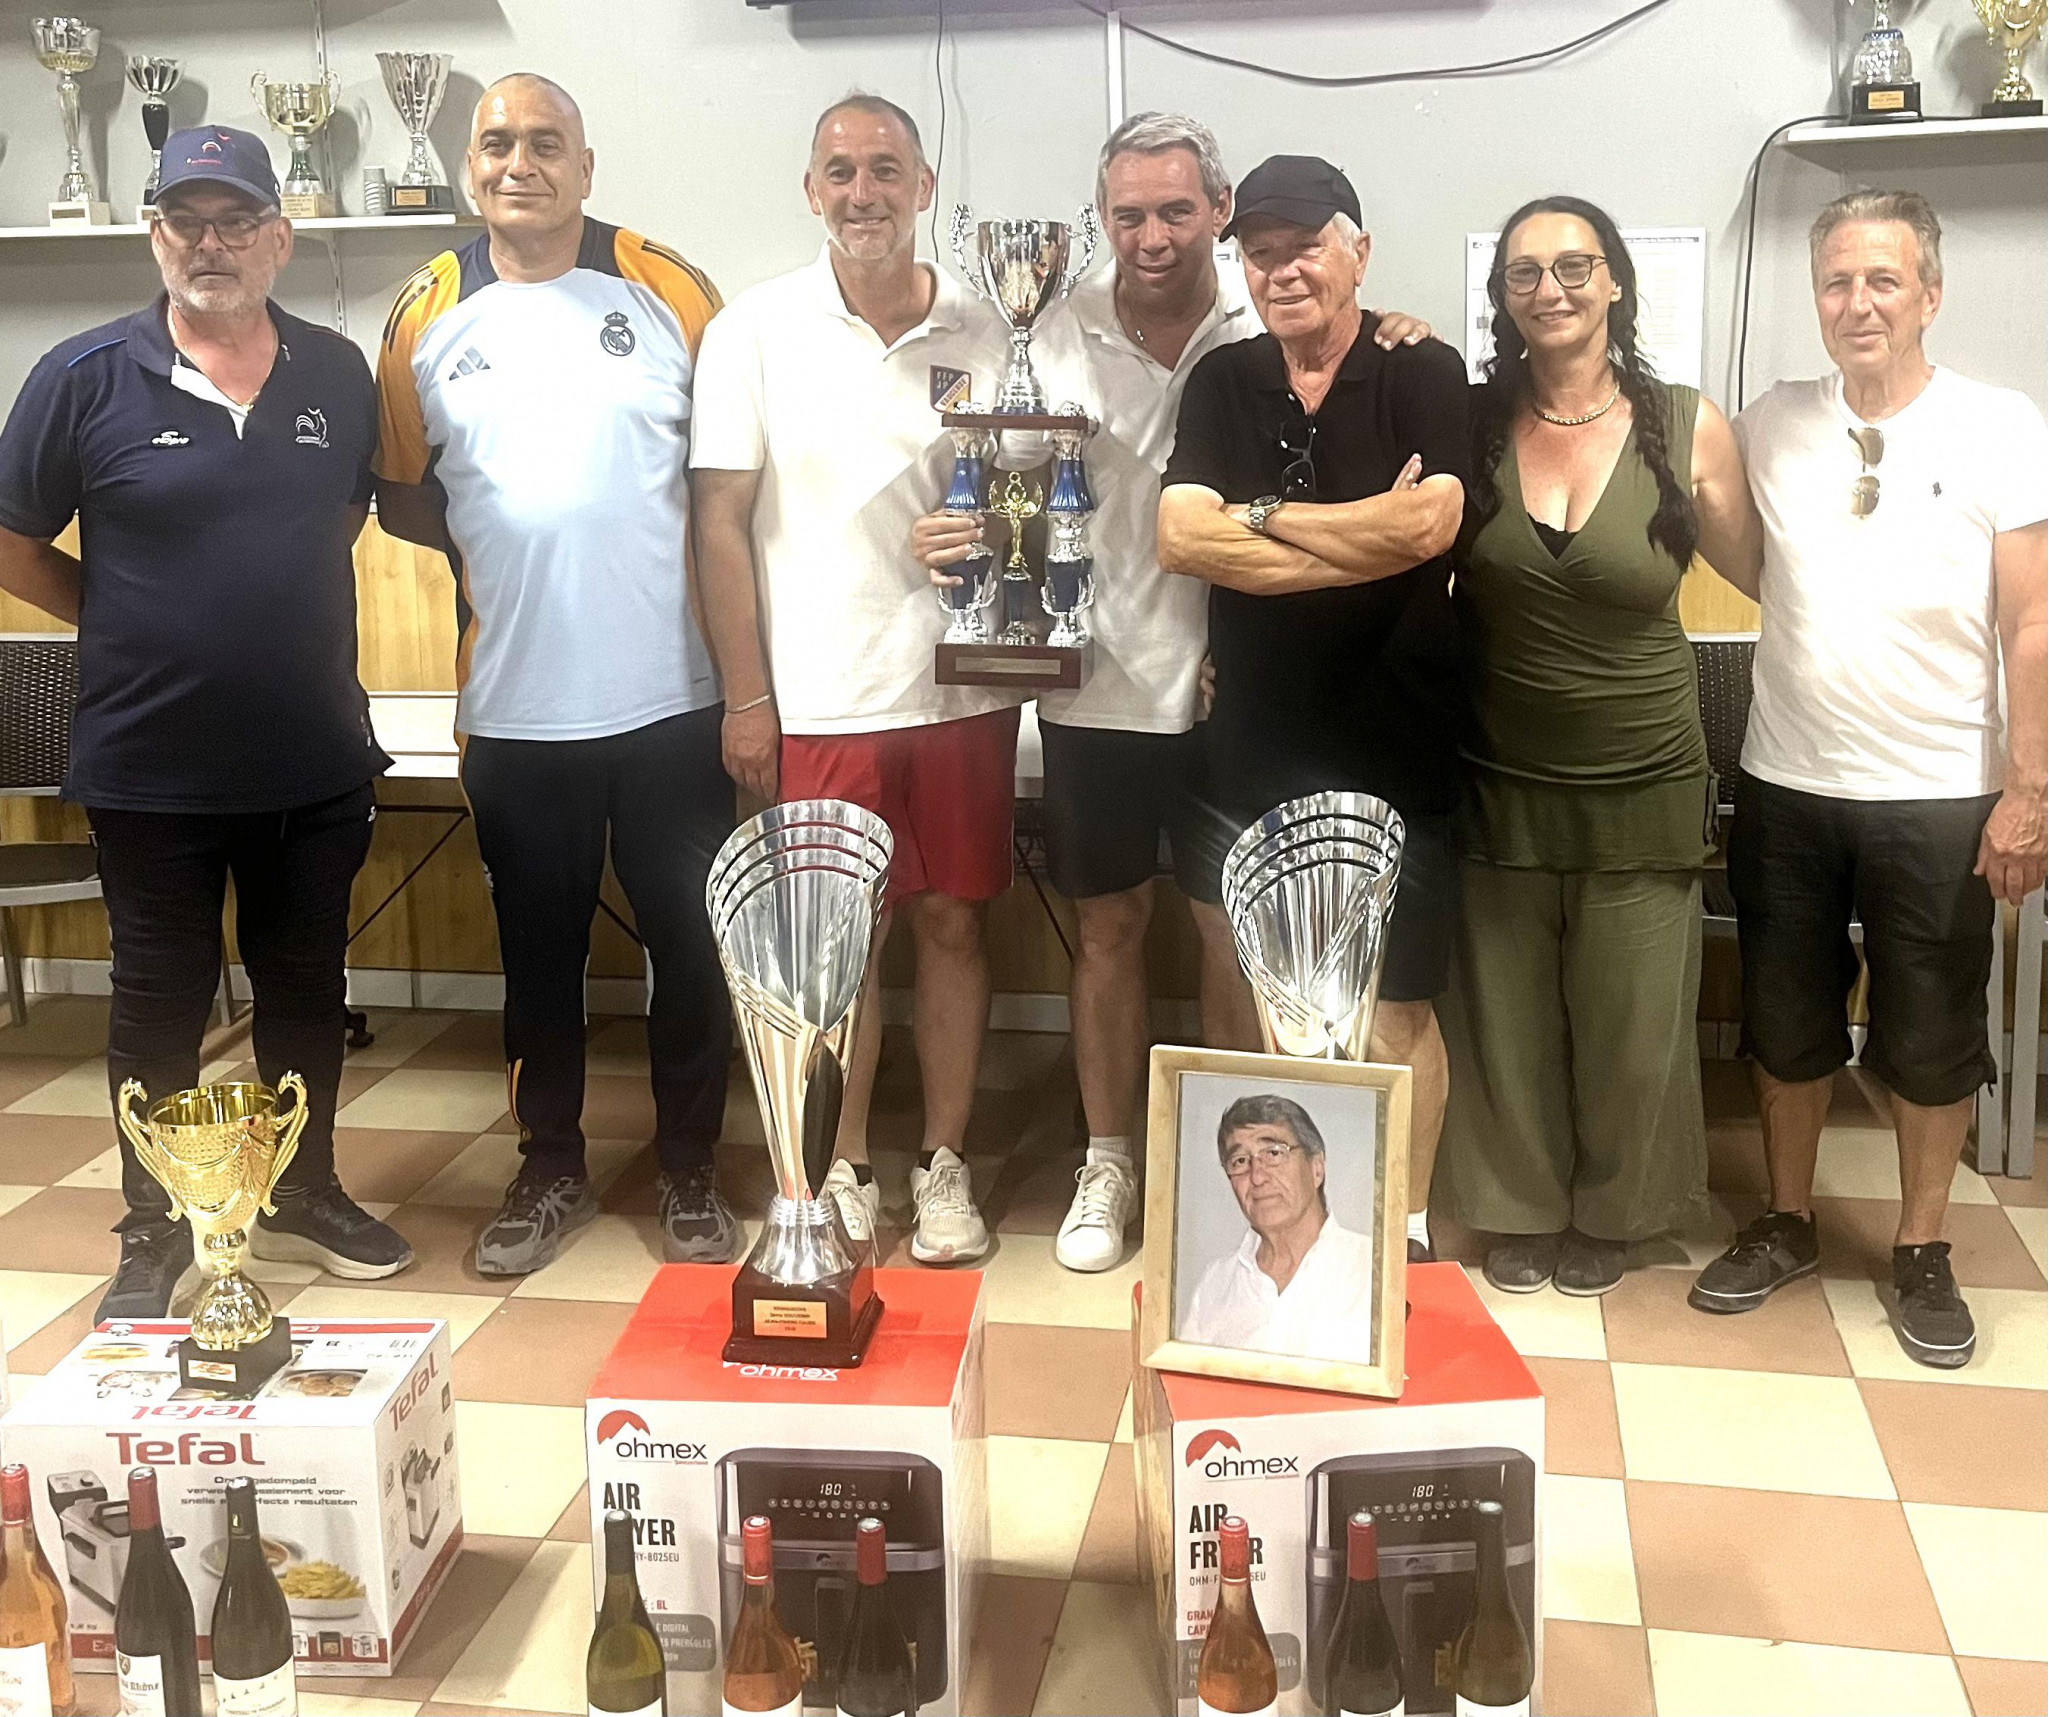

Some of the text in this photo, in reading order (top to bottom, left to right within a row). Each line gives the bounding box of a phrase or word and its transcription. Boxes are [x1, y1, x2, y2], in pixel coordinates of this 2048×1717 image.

[739, 1364, 840, 1379] ohmex
[389, 1351, 439, 1432] Tefal
[106, 1432, 265, 1465] Tefal
[616, 1437, 708, 1460] ohmex
[1205, 1456, 1299, 1478] ohmex
[603, 1482, 641, 1510] AIR
[820, 1483, 842, 1496] 180
[1412, 1485, 1435, 1498] 180
[294, 1498, 358, 1506] resultaten
[1189, 1503, 1229, 1534] AIR
[632, 1518, 676, 1546] YER
[1187, 1609, 1214, 1621] GRAN
